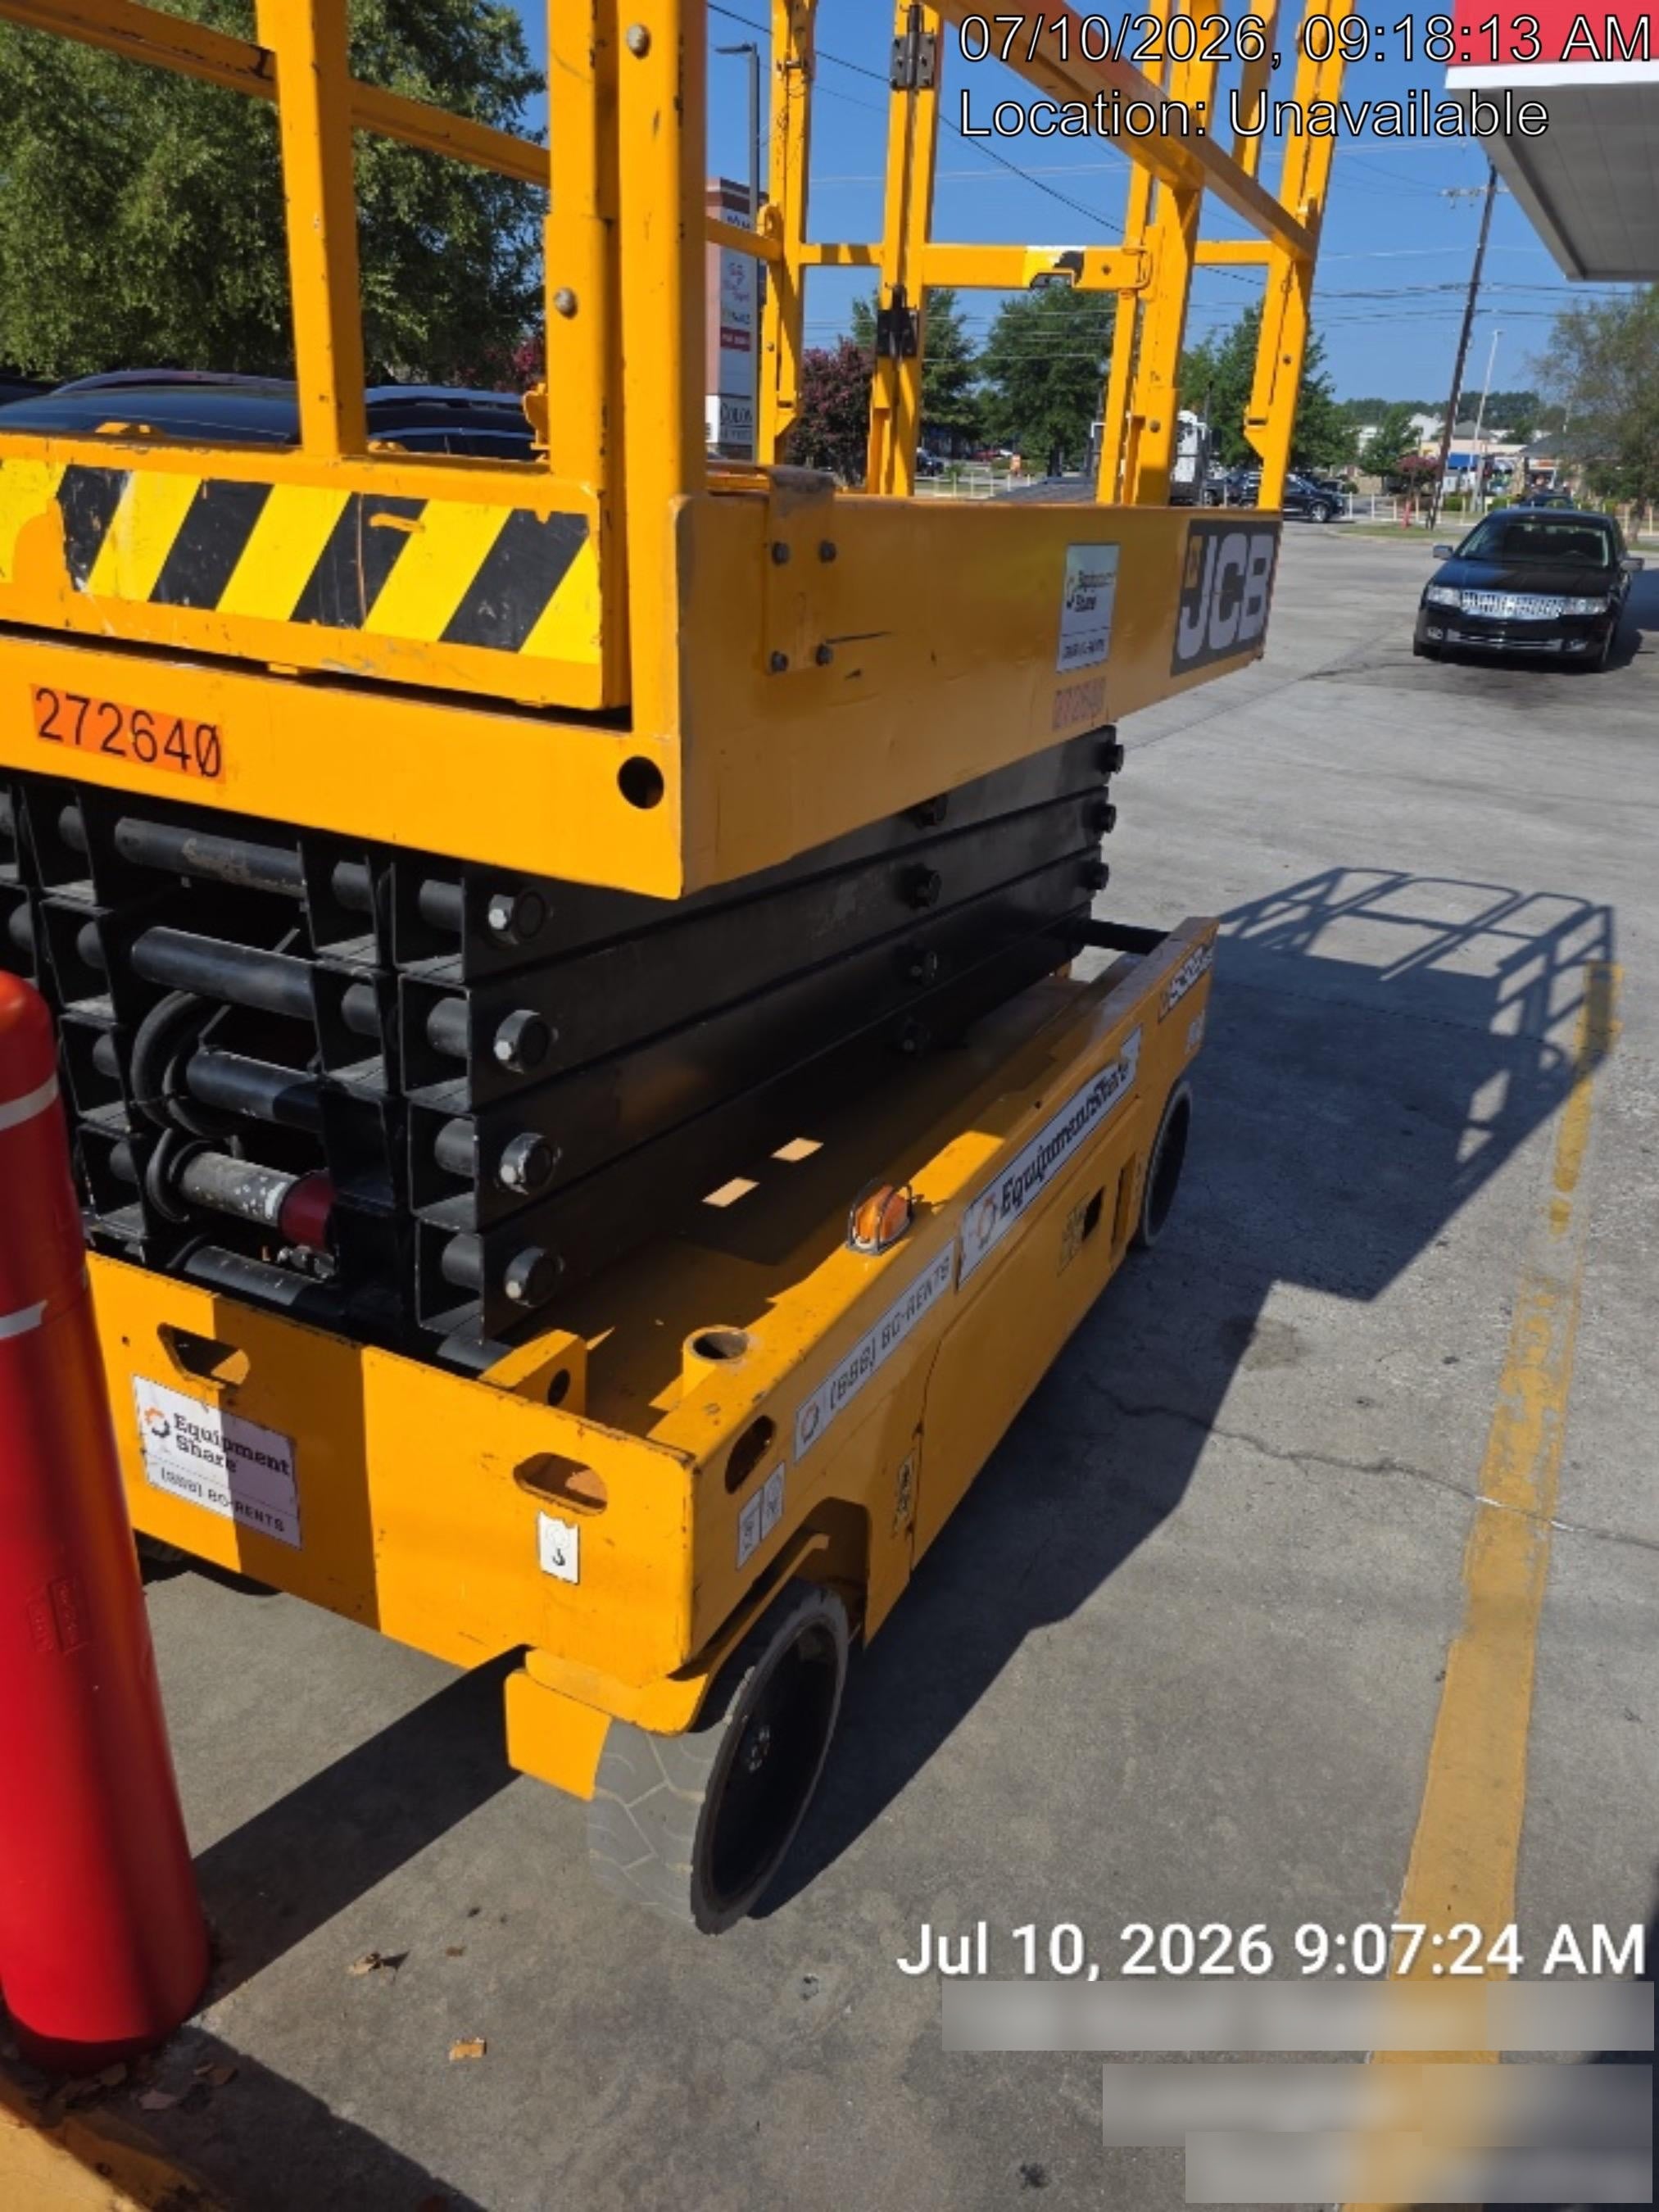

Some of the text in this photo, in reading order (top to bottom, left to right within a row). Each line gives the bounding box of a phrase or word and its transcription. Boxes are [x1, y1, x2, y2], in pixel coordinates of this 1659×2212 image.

[1177, 533, 1276, 660] JCB
[35, 687, 222, 778] 272640
[174, 1412, 290, 1475] Equipment
[175, 1434, 237, 1473] Share
